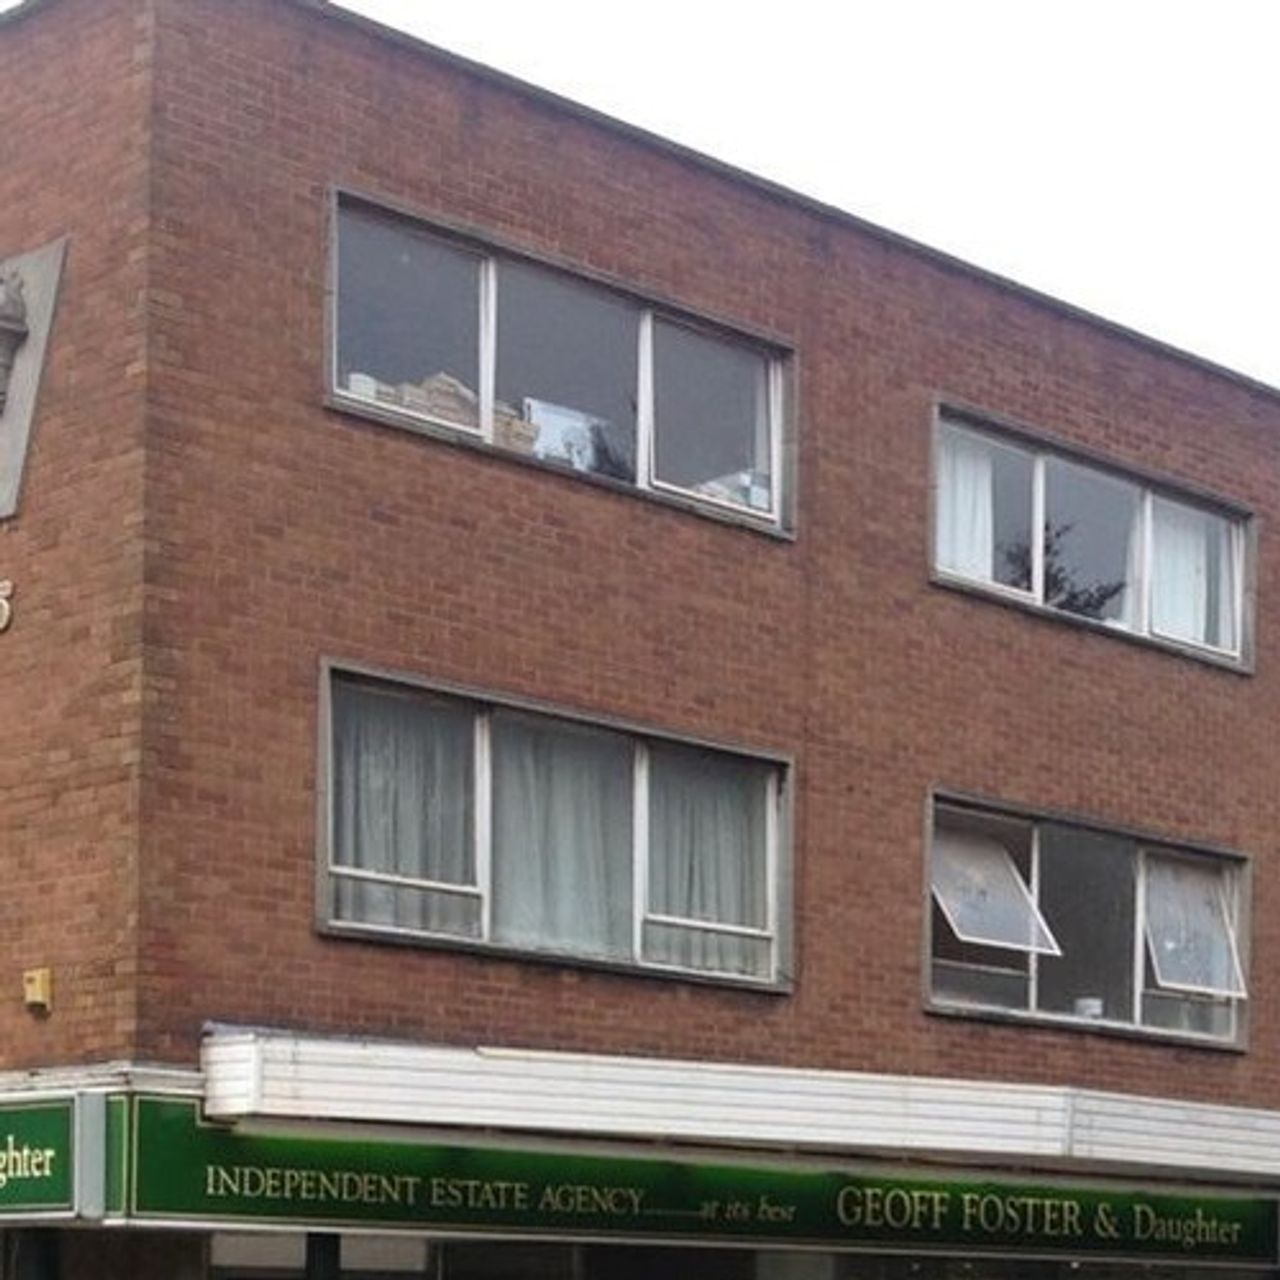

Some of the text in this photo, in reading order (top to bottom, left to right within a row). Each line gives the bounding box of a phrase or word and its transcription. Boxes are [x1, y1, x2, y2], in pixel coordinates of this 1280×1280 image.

[206, 1164, 647, 1215] INDEPENDENT ESTATE AGENCY
[836, 1186, 1242, 1250] GEOFF FOSTER & Daughter
